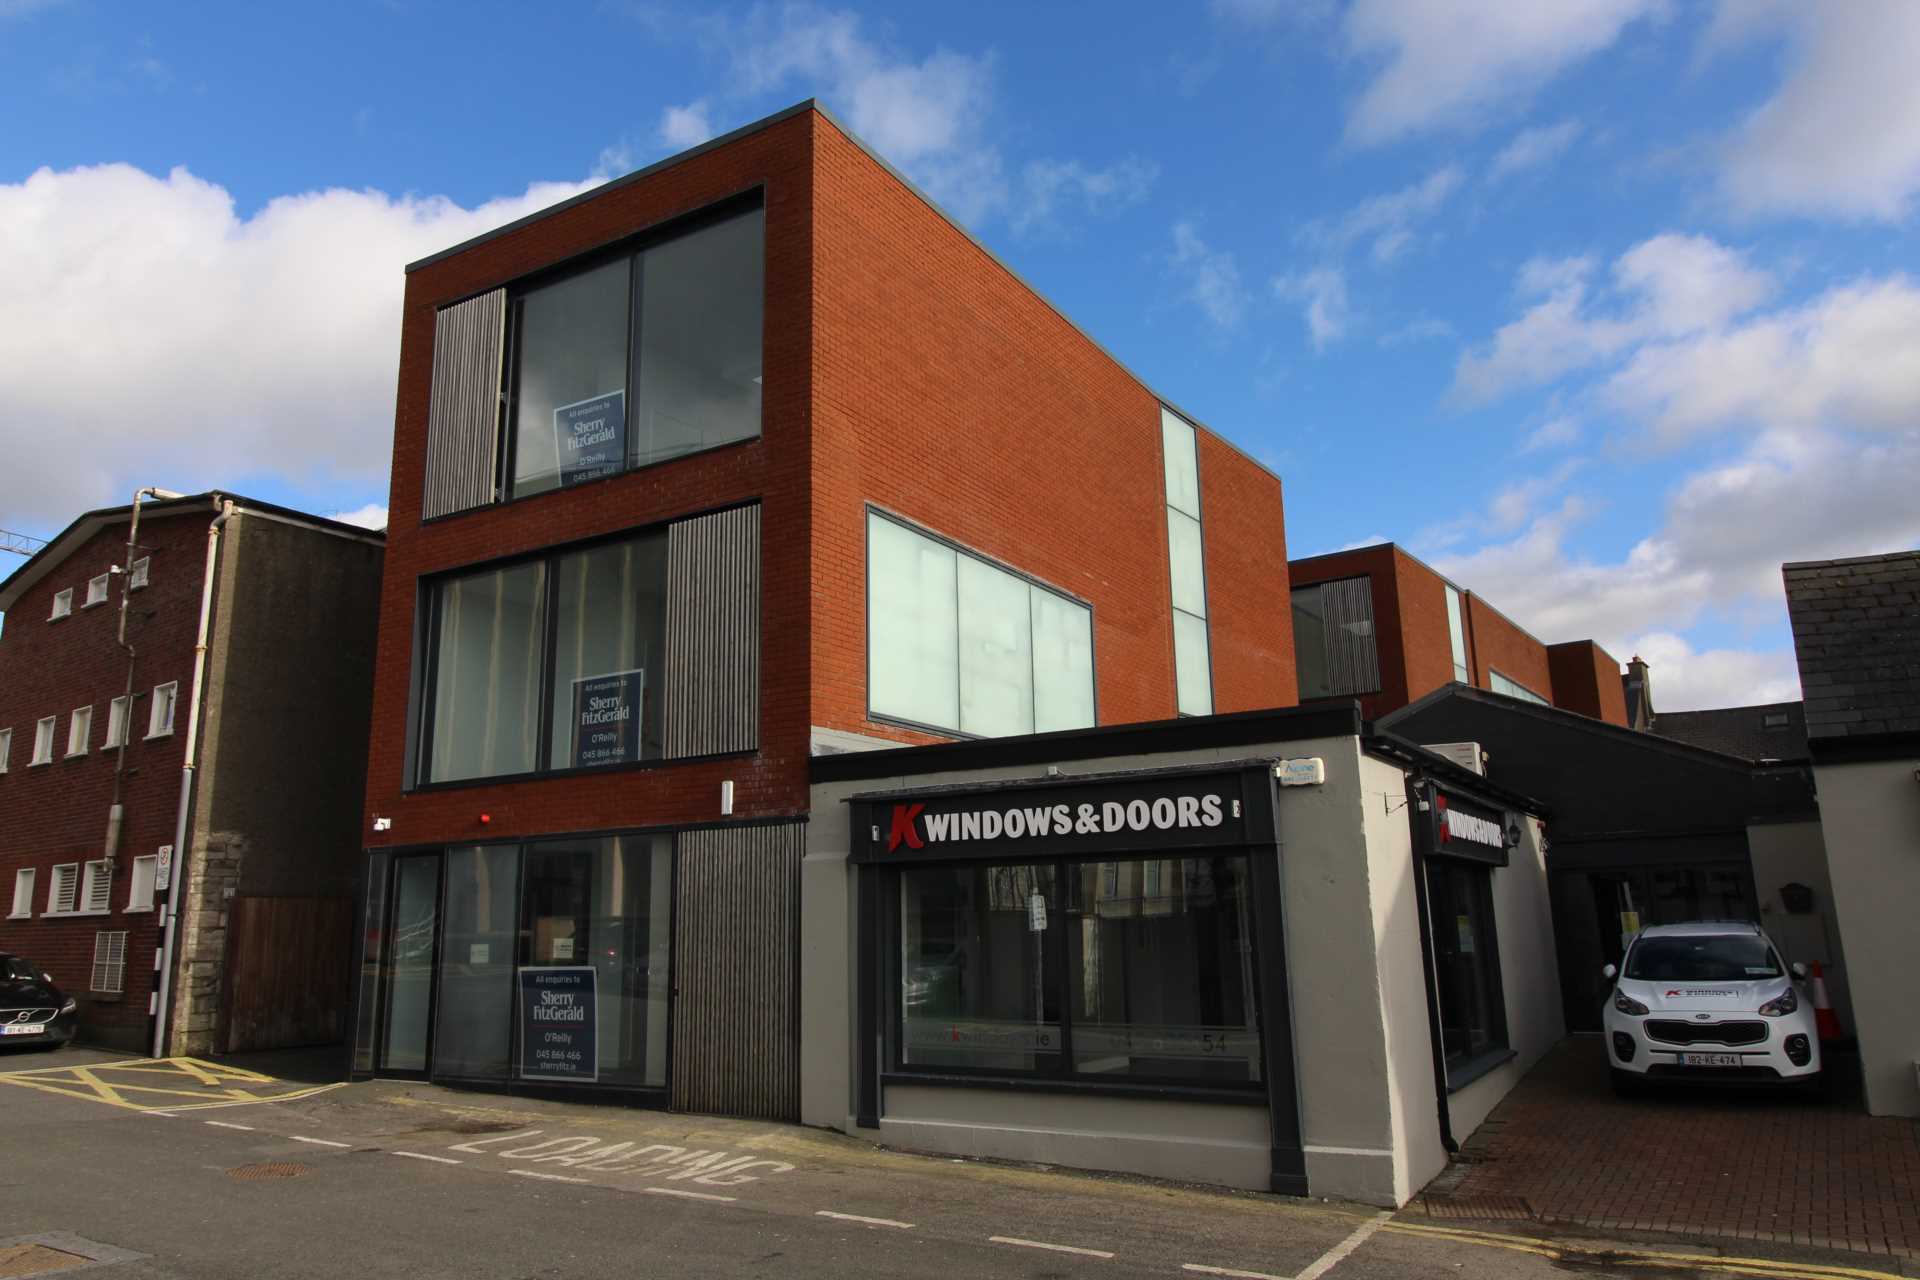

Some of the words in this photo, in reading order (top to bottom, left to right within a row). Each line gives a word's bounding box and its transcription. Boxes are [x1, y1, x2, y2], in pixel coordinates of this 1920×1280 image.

[574, 417, 606, 436] Sherry
[589, 696, 622, 712] Sherry
[581, 705, 630, 726] FitzGerald
[924, 794, 1223, 842] WINDOWS&DOORS
[545, 976, 573, 985] enquiries
[573, 975, 581, 984] to
[541, 990, 576, 1006] Sherry
[533, 1005, 585, 1021] FitzGerald
[544, 1032, 572, 1044] O'Reilly
[536, 1049, 550, 1059] 045
[448, 1130, 796, 1185] LOADING
